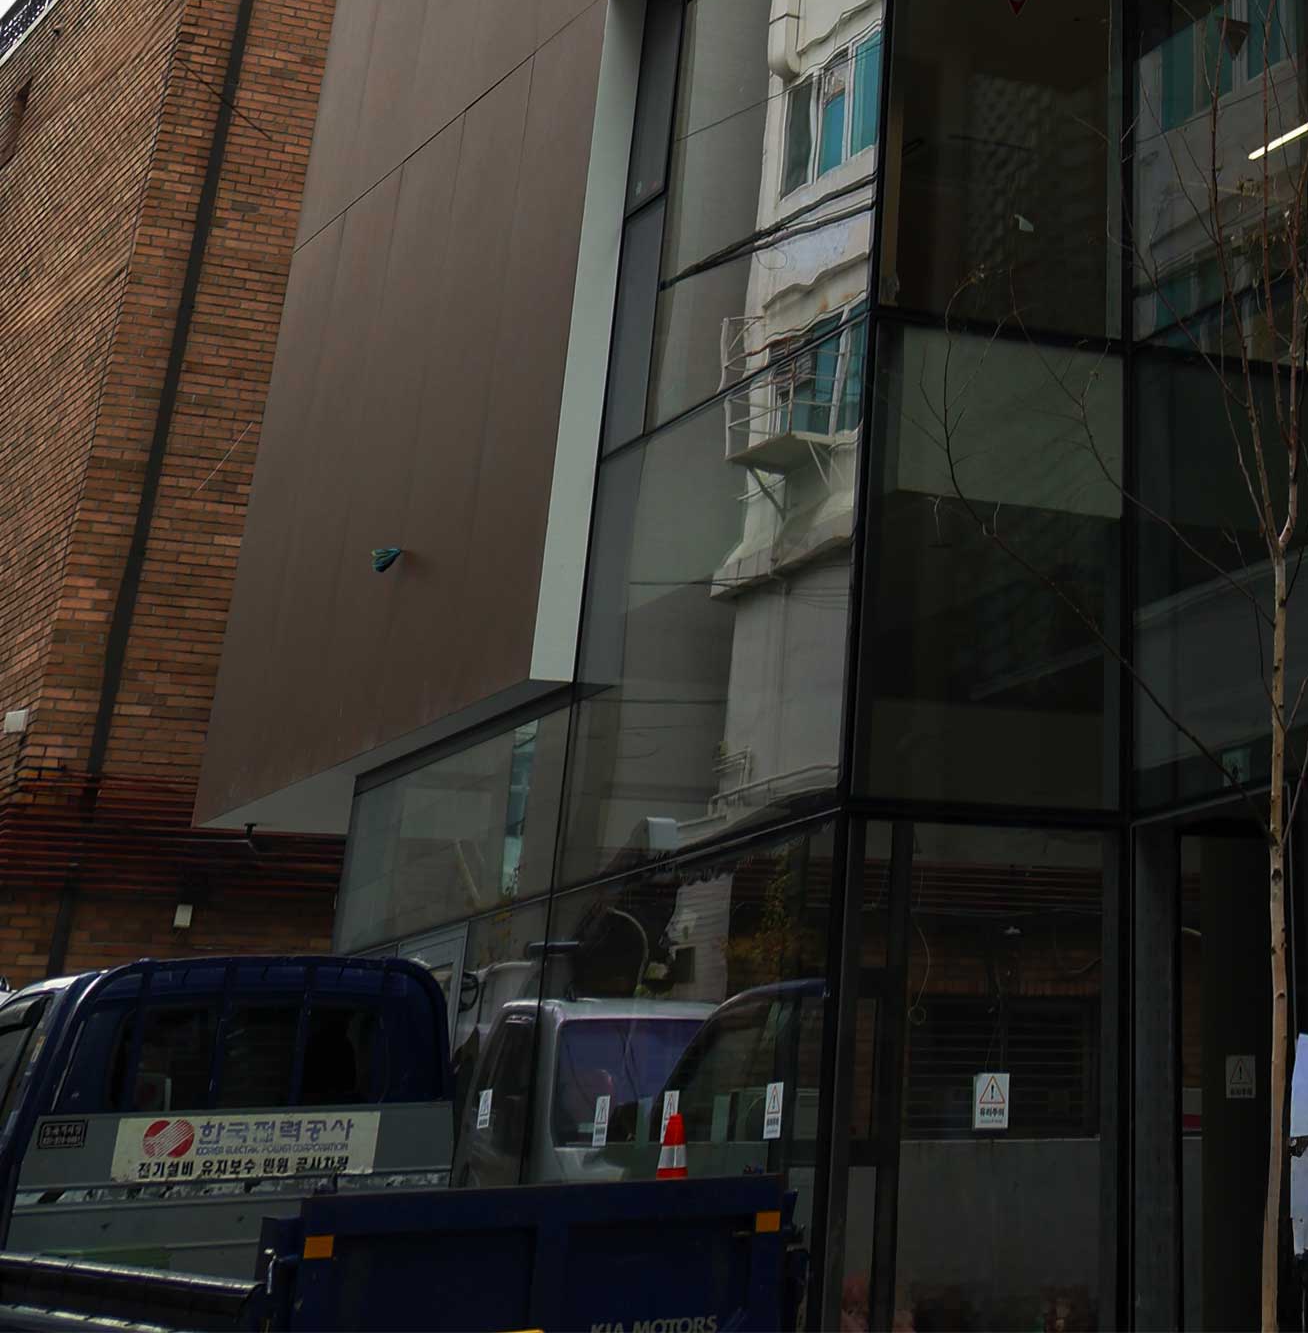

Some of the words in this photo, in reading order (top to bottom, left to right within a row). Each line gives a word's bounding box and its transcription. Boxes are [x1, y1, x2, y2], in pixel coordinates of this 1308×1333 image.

[201, 1158, 256, 1176] 유지보수
[590, 1321, 625, 1333] KIA
[632, 1315, 718, 1333] MOTORS
